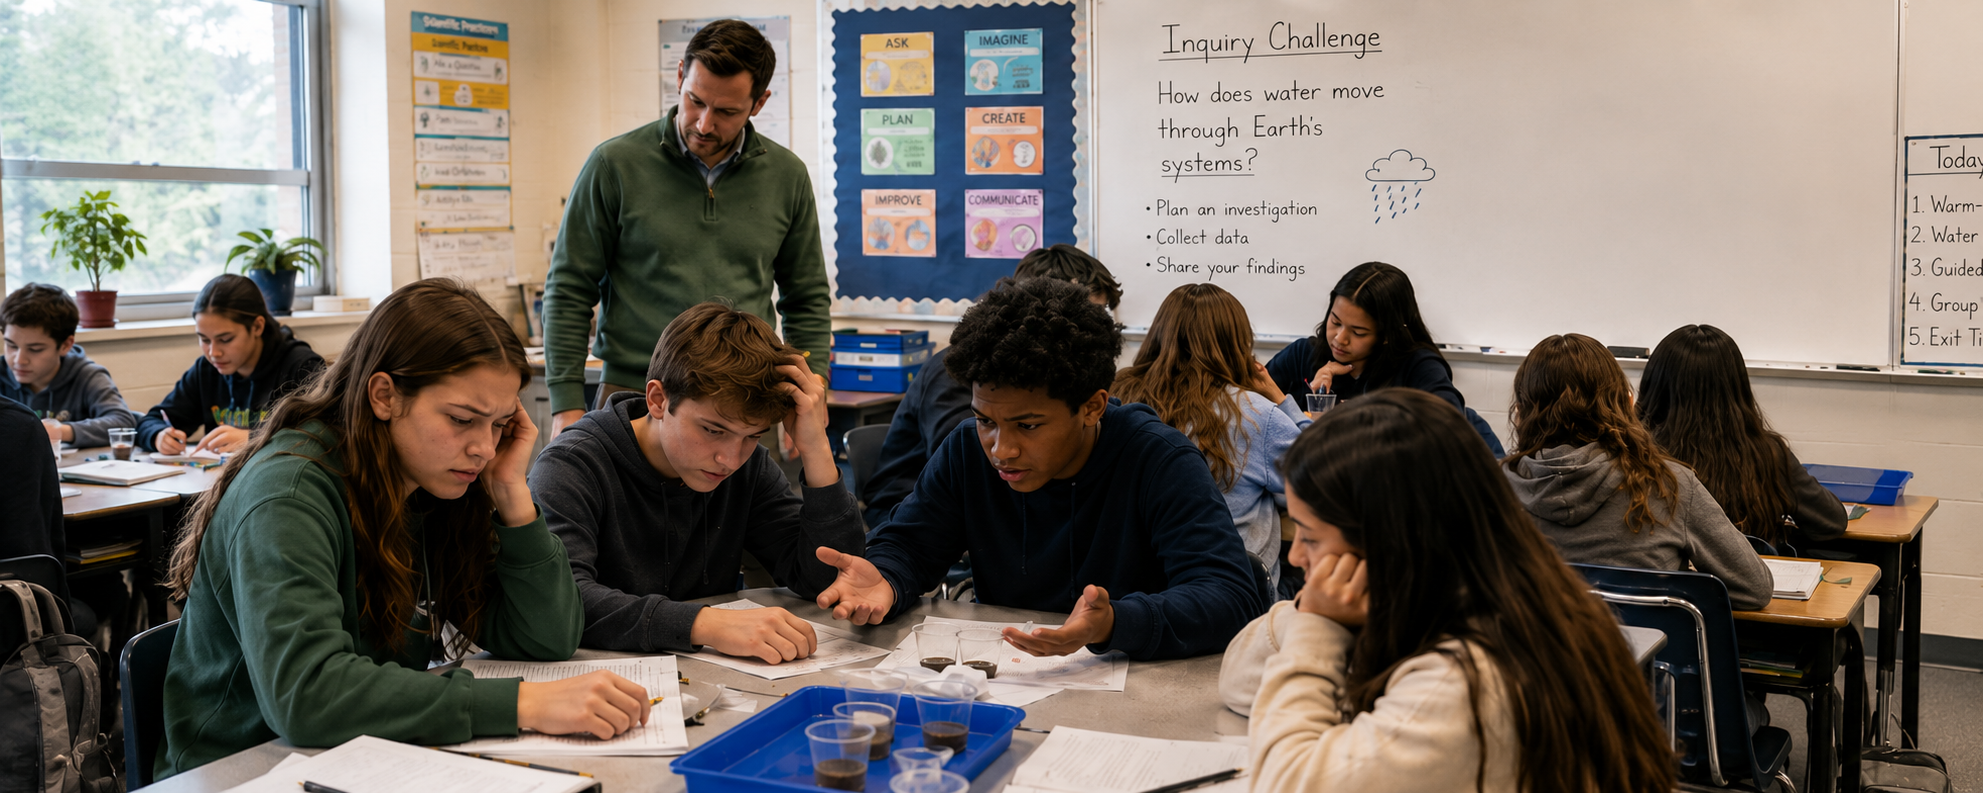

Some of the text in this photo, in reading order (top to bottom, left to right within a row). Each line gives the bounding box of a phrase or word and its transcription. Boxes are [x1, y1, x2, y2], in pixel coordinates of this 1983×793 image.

[885, 38, 909, 49] ASK
[979, 34, 1029, 46] IMAGINE
[1161, 21, 1382, 63] Inquiry Challenge
[1158, 80, 1385, 104] How does water move
[882, 114, 914, 125] PLAN
[982, 112, 1026, 124] CREATE
[1158, 114, 1323, 147] through Earth's
[1161, 147, 1258, 183] systems?
[875, 195, 922, 206] IMPROVE
[968, 195, 1039, 206] COMMUNICATE
[1912, 195, 1983, 213] 1. Warm-
[1157, 199, 1317, 223] Plan an investigation
[1156, 228, 1250, 245] Collect data
[1910, 225, 1979, 243] 2. Water
[1157, 256, 1306, 282] Share your findings
[1910, 257, 1983, 277] 3. Guided
[1909, 291, 1979, 320] 4. Group
[1909, 326, 1982, 346] 5. Exit Ti
